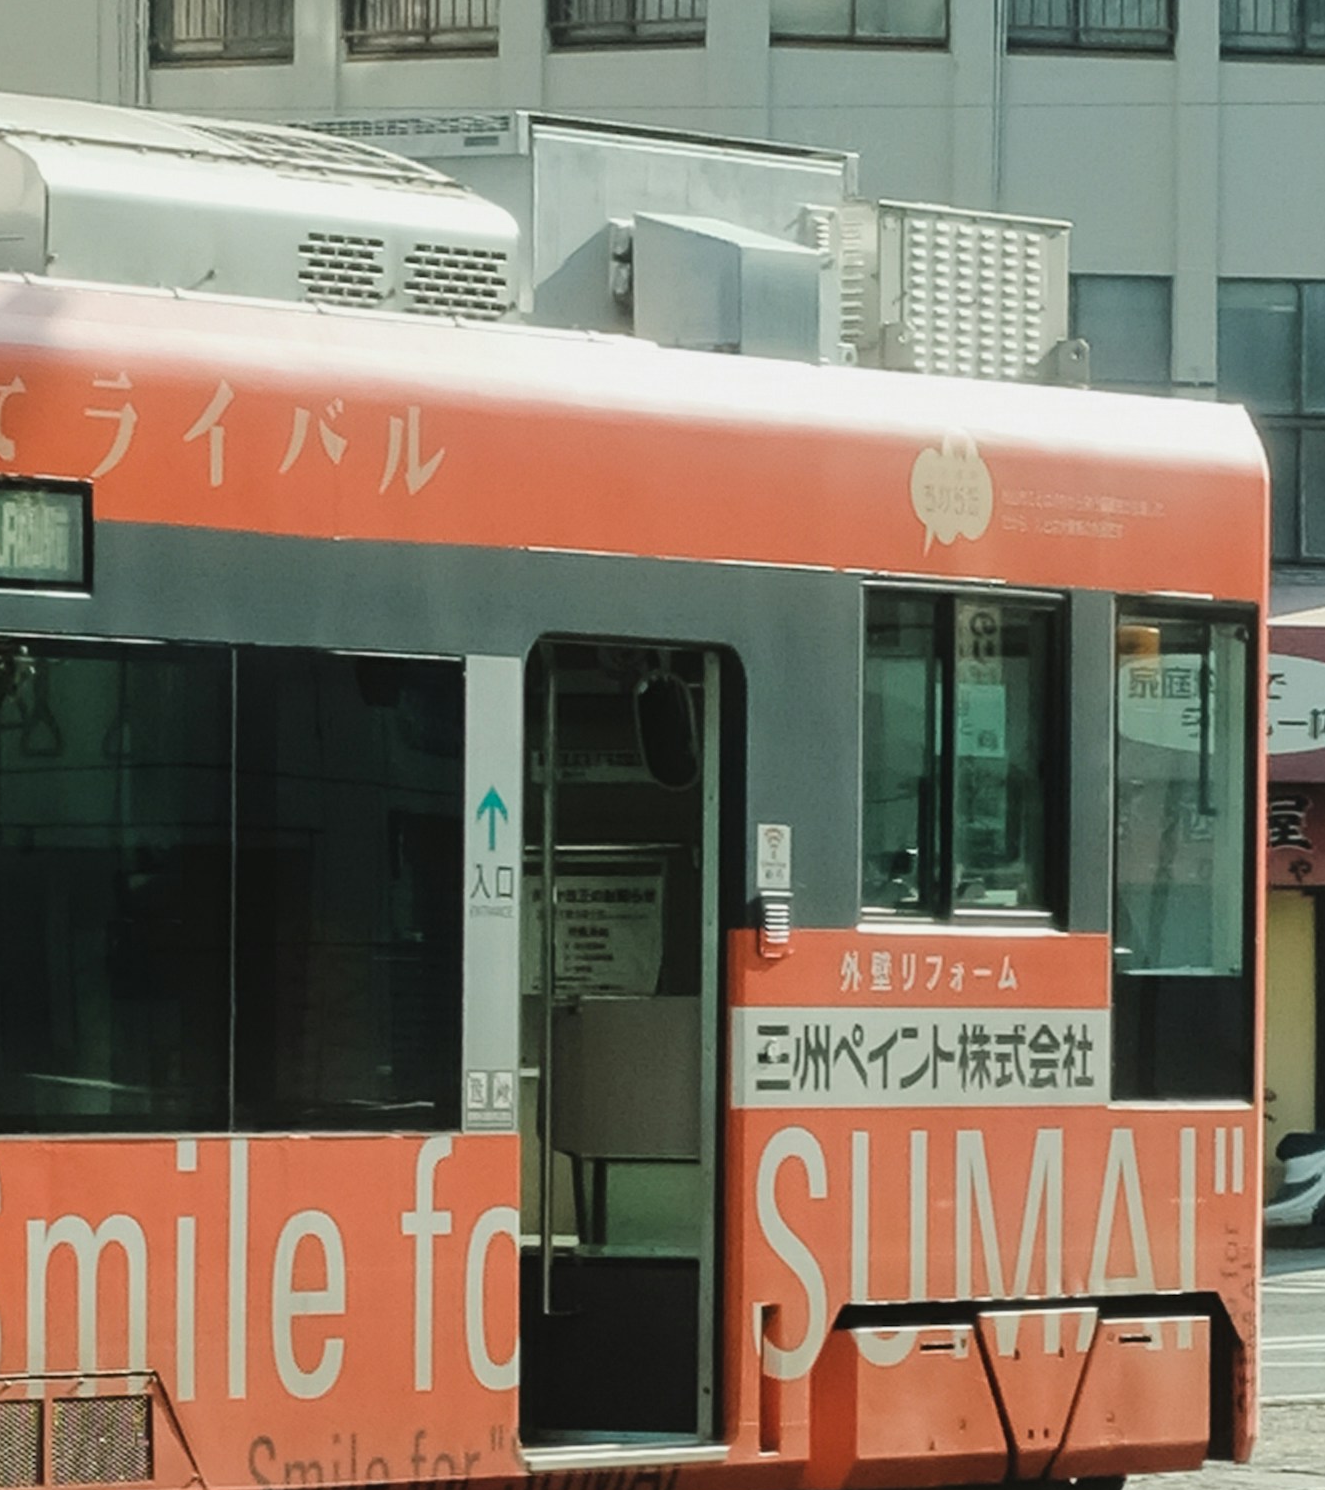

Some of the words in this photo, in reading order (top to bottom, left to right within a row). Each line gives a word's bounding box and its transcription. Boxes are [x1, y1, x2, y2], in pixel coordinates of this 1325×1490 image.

[470, 863, 514, 899] 入口
[840, 950, 1018, 994] 外壁リフォーム
[756, 1022, 1095, 1092] 三州ペイント株式会社
